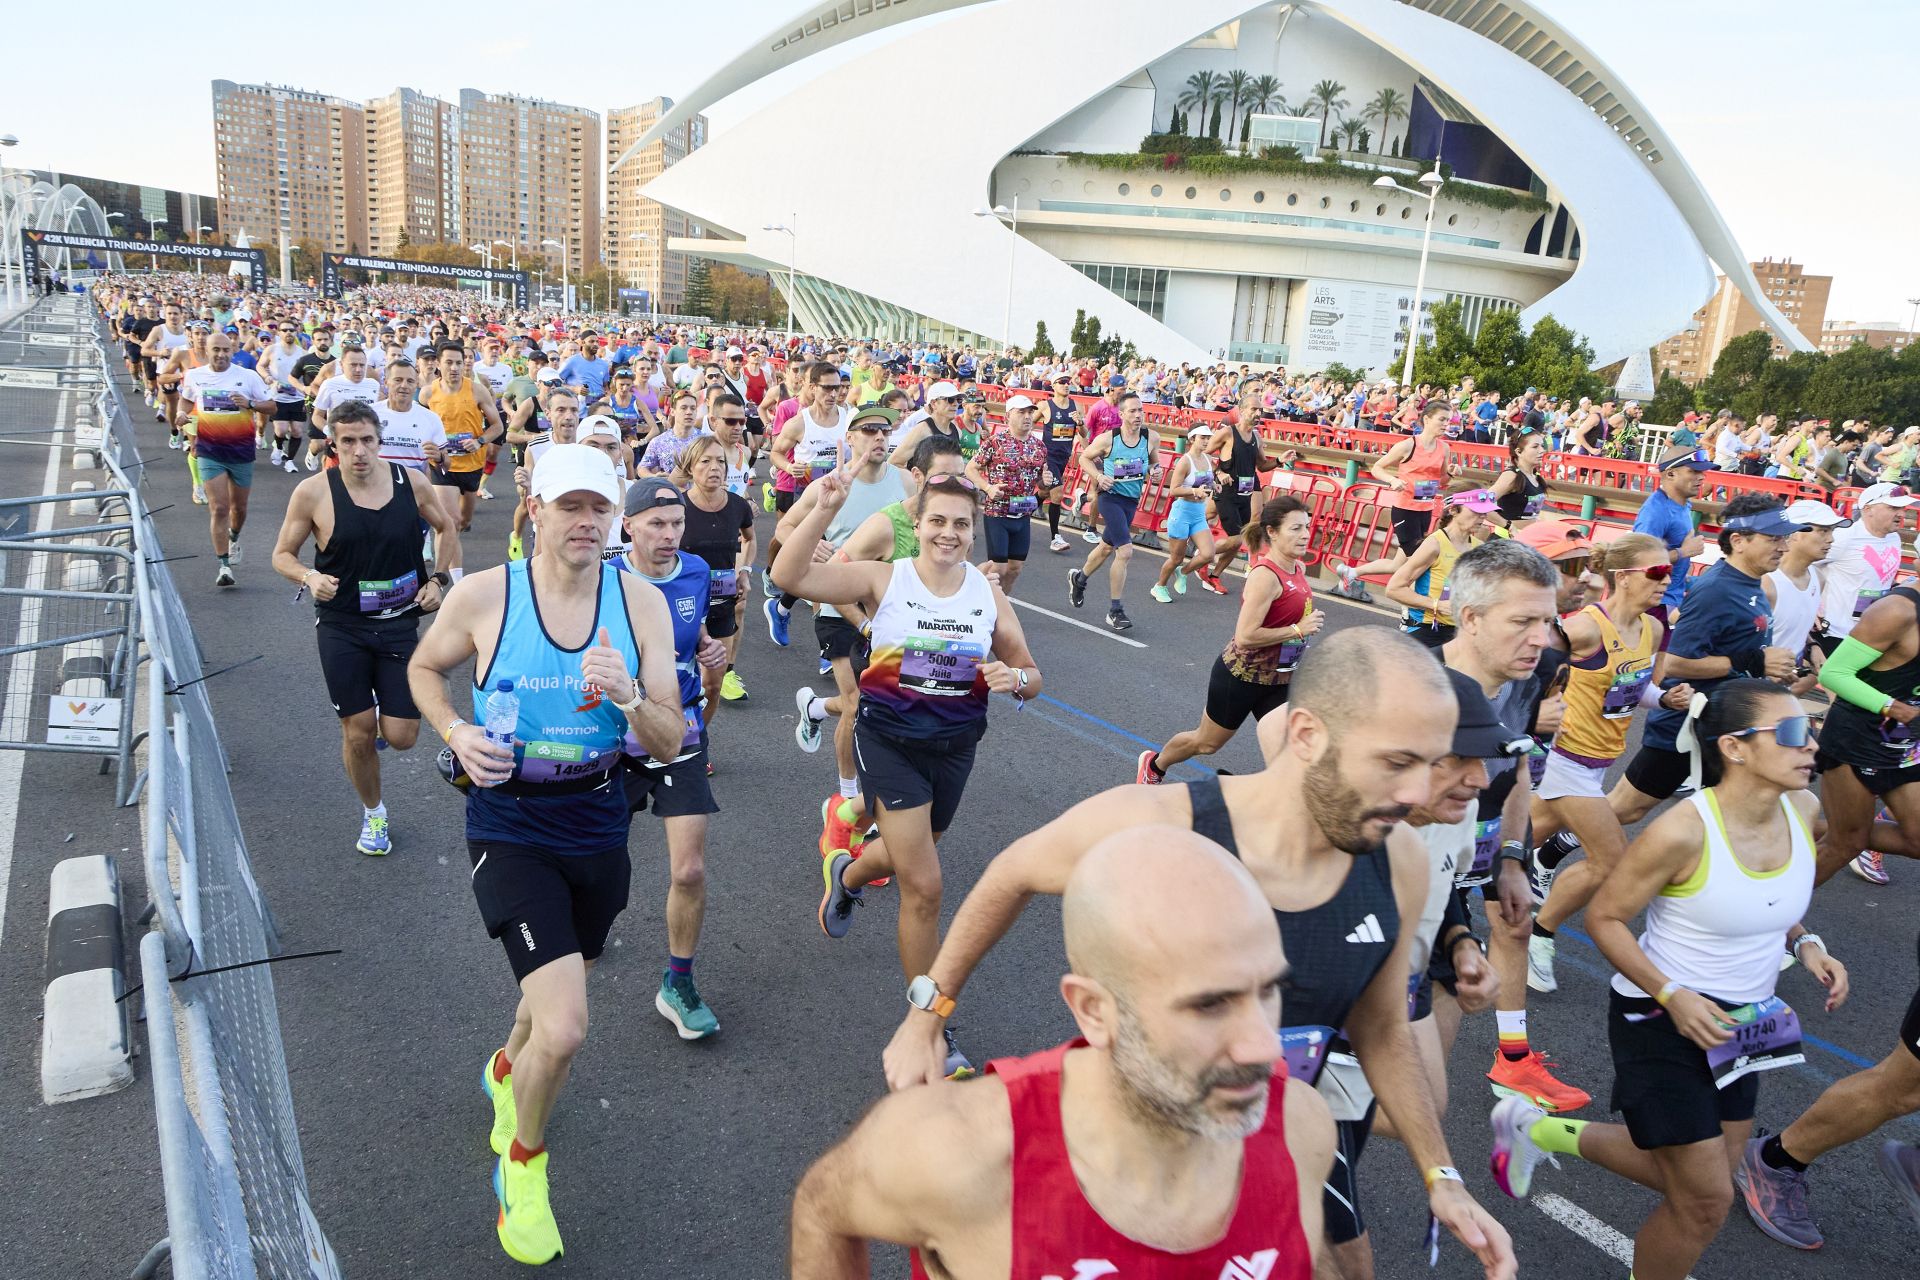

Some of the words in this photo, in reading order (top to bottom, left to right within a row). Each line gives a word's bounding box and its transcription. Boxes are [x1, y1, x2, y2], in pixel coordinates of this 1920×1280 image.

[44, 234, 62, 244] 42K
[64, 235, 107, 248] VALENCIA
[107, 240, 159, 252] TRINIDAD
[160, 244, 211, 256] ALFONSO
[223, 250, 248, 258] ZURICH
[343, 257, 359, 266] 42K
[360, 259, 396, 270] VALENCIA
[396, 262, 439, 274] TRINIDAD
[439, 266, 483, 278] ALFONSO
[1315, 287, 1330, 296] LES
[1313, 296, 1336, 305] ARTS
[917, 619, 974, 634] MARATHON
[928, 653, 958, 667] 5000
[517, 674, 560, 693] Aqua
[593, 693, 609, 701] tea
[542, 725, 599, 736] IMMOTION
[519, 922, 537, 951] FUSION
[1735, 1018, 1777, 1043] 11740
